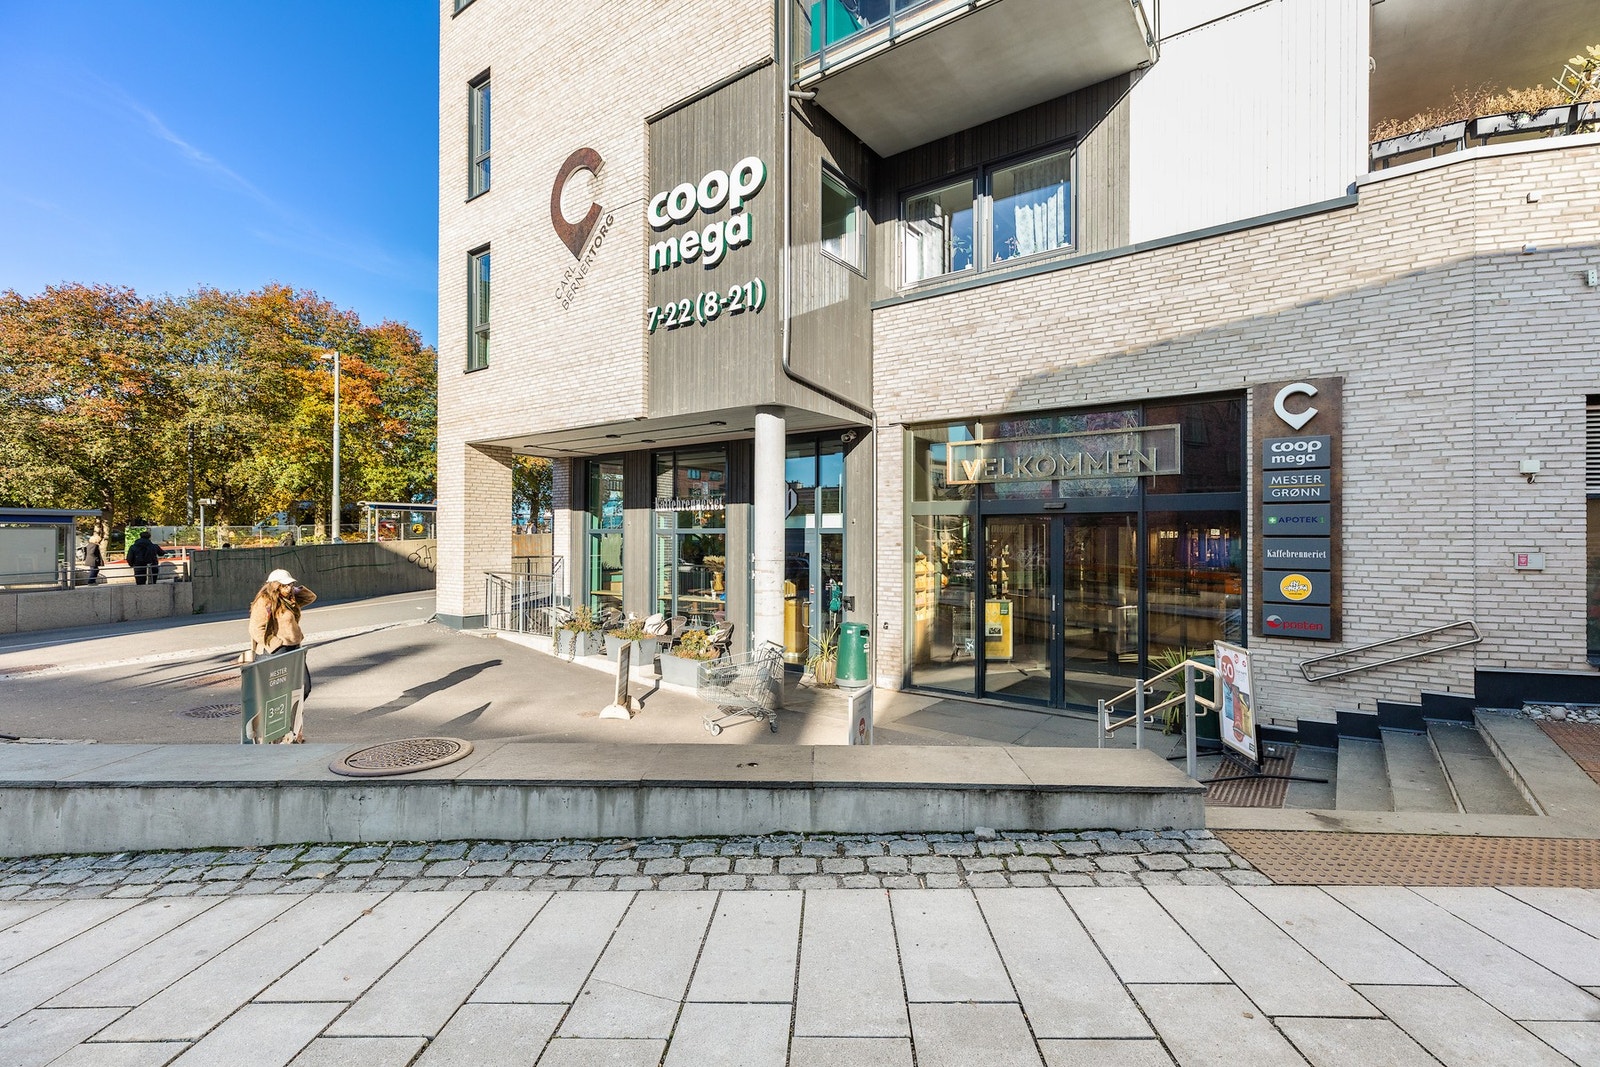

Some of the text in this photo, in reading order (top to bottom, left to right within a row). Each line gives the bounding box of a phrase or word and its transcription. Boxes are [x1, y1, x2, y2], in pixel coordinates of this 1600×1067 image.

[648, 156, 767, 231] coop
[649, 212, 752, 270] mega
[555, 266, 576, 300] CARL
[1271, 440, 1322, 453] coop
[961, 448, 1157, 482] VELKOMMEN
[1271, 453, 1316, 465] mega
[1271, 474, 1322, 485] MESTER
[1271, 487, 1320, 497] GRØNN
[1278, 516, 1325, 524] APOTEK 1
[1266, 549, 1327, 559] Kaffebrenneriet
[1282, 620, 1324, 631] posten
